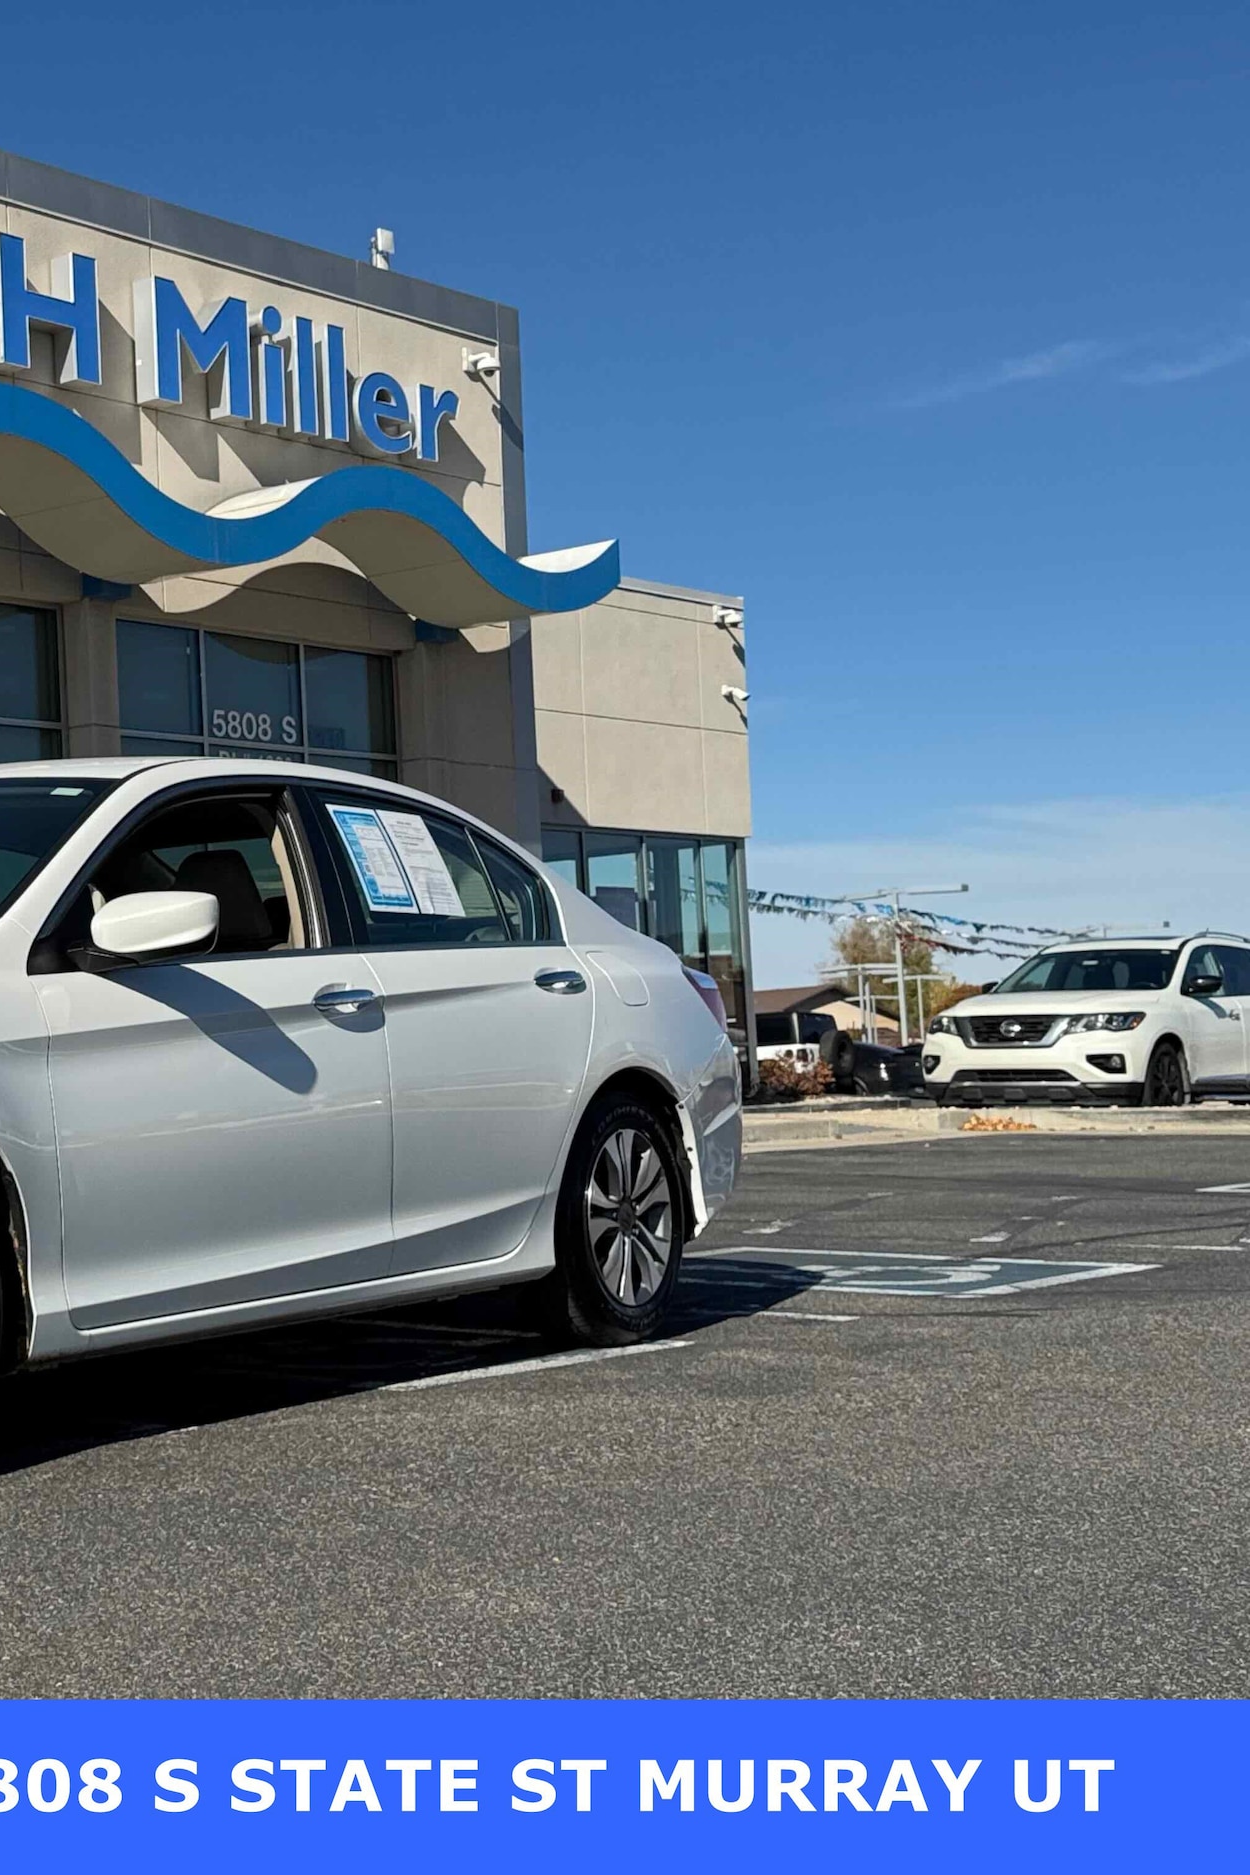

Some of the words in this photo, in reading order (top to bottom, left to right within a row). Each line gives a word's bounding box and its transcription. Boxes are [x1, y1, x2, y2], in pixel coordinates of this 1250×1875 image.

[146, 276, 460, 463] Miller
[212, 709, 272, 742] 5808
[281, 715, 297, 744] S
